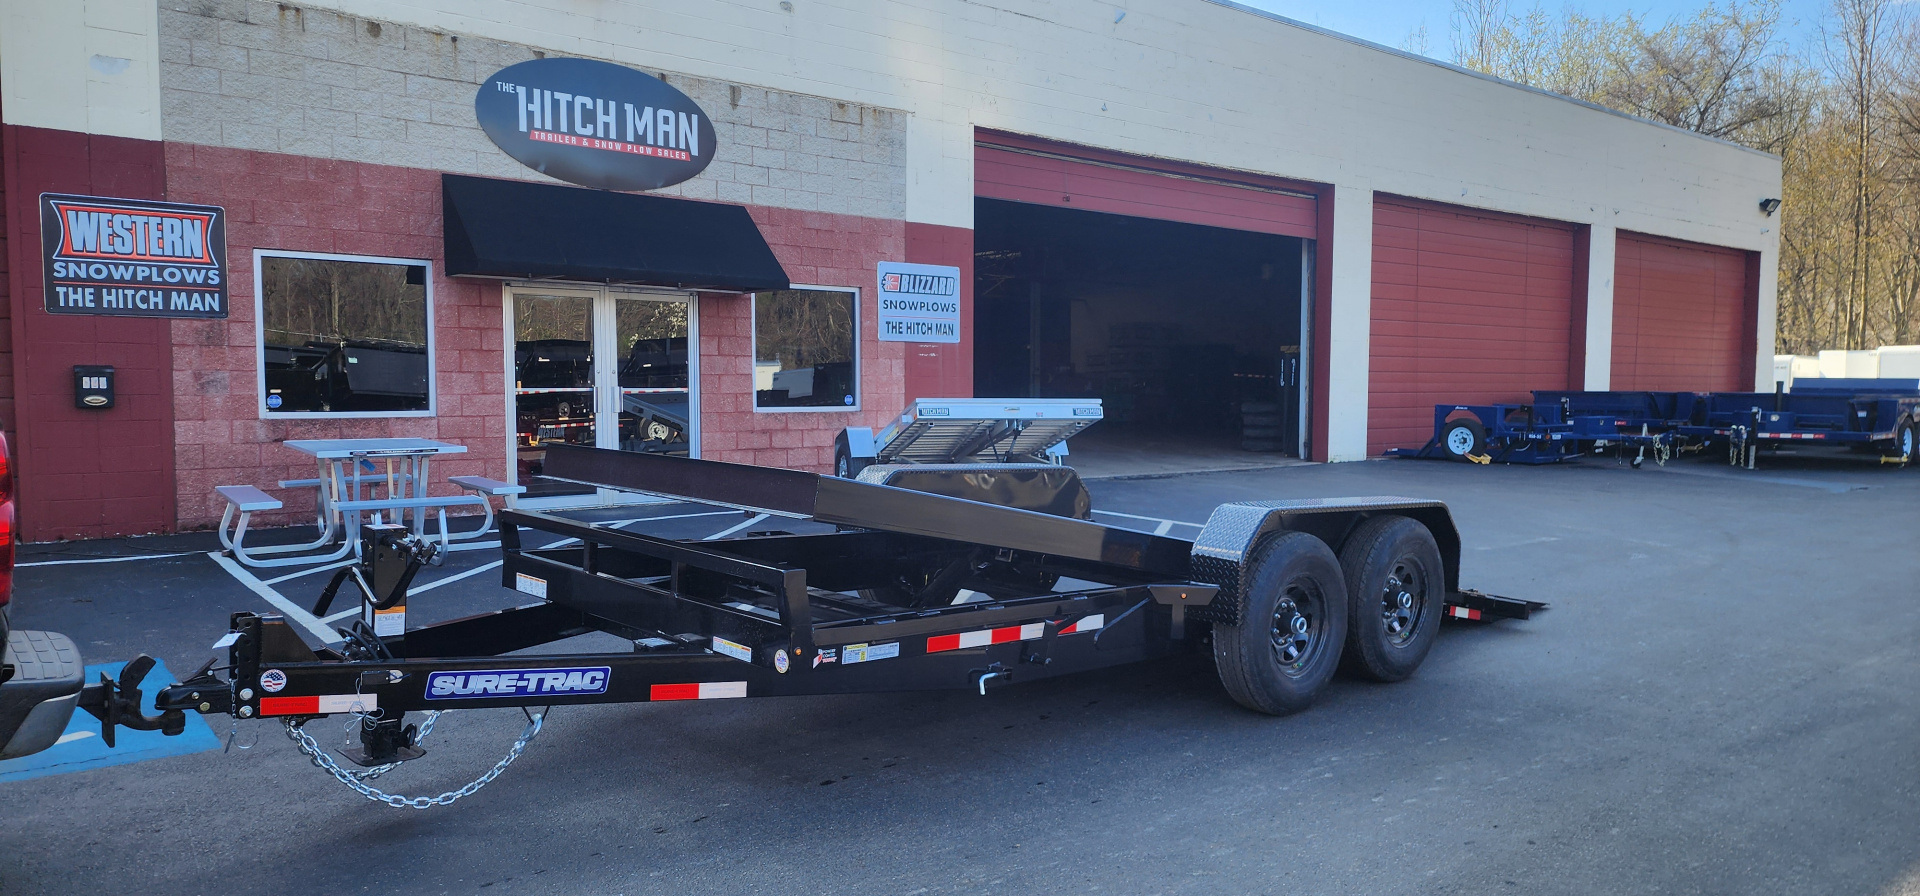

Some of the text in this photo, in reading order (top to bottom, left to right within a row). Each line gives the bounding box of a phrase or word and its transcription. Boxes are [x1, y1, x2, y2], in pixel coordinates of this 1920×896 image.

[496, 81, 515, 94] THE
[516, 85, 699, 156] HITCH MAN
[534, 131, 686, 160] TRAILER & SNOW PLOW SALES
[66, 210, 203, 258] WESTERN
[53, 262, 220, 284] SNOWPLOWS
[900, 274, 955, 295] BLIZZARD
[56, 286, 220, 312] THE HITCH MAN
[883, 299, 956, 313] SNOWPLOWS
[886, 321, 954, 336] THE HITCH MAN
[431, 671, 605, 695] SURE-TRAC
